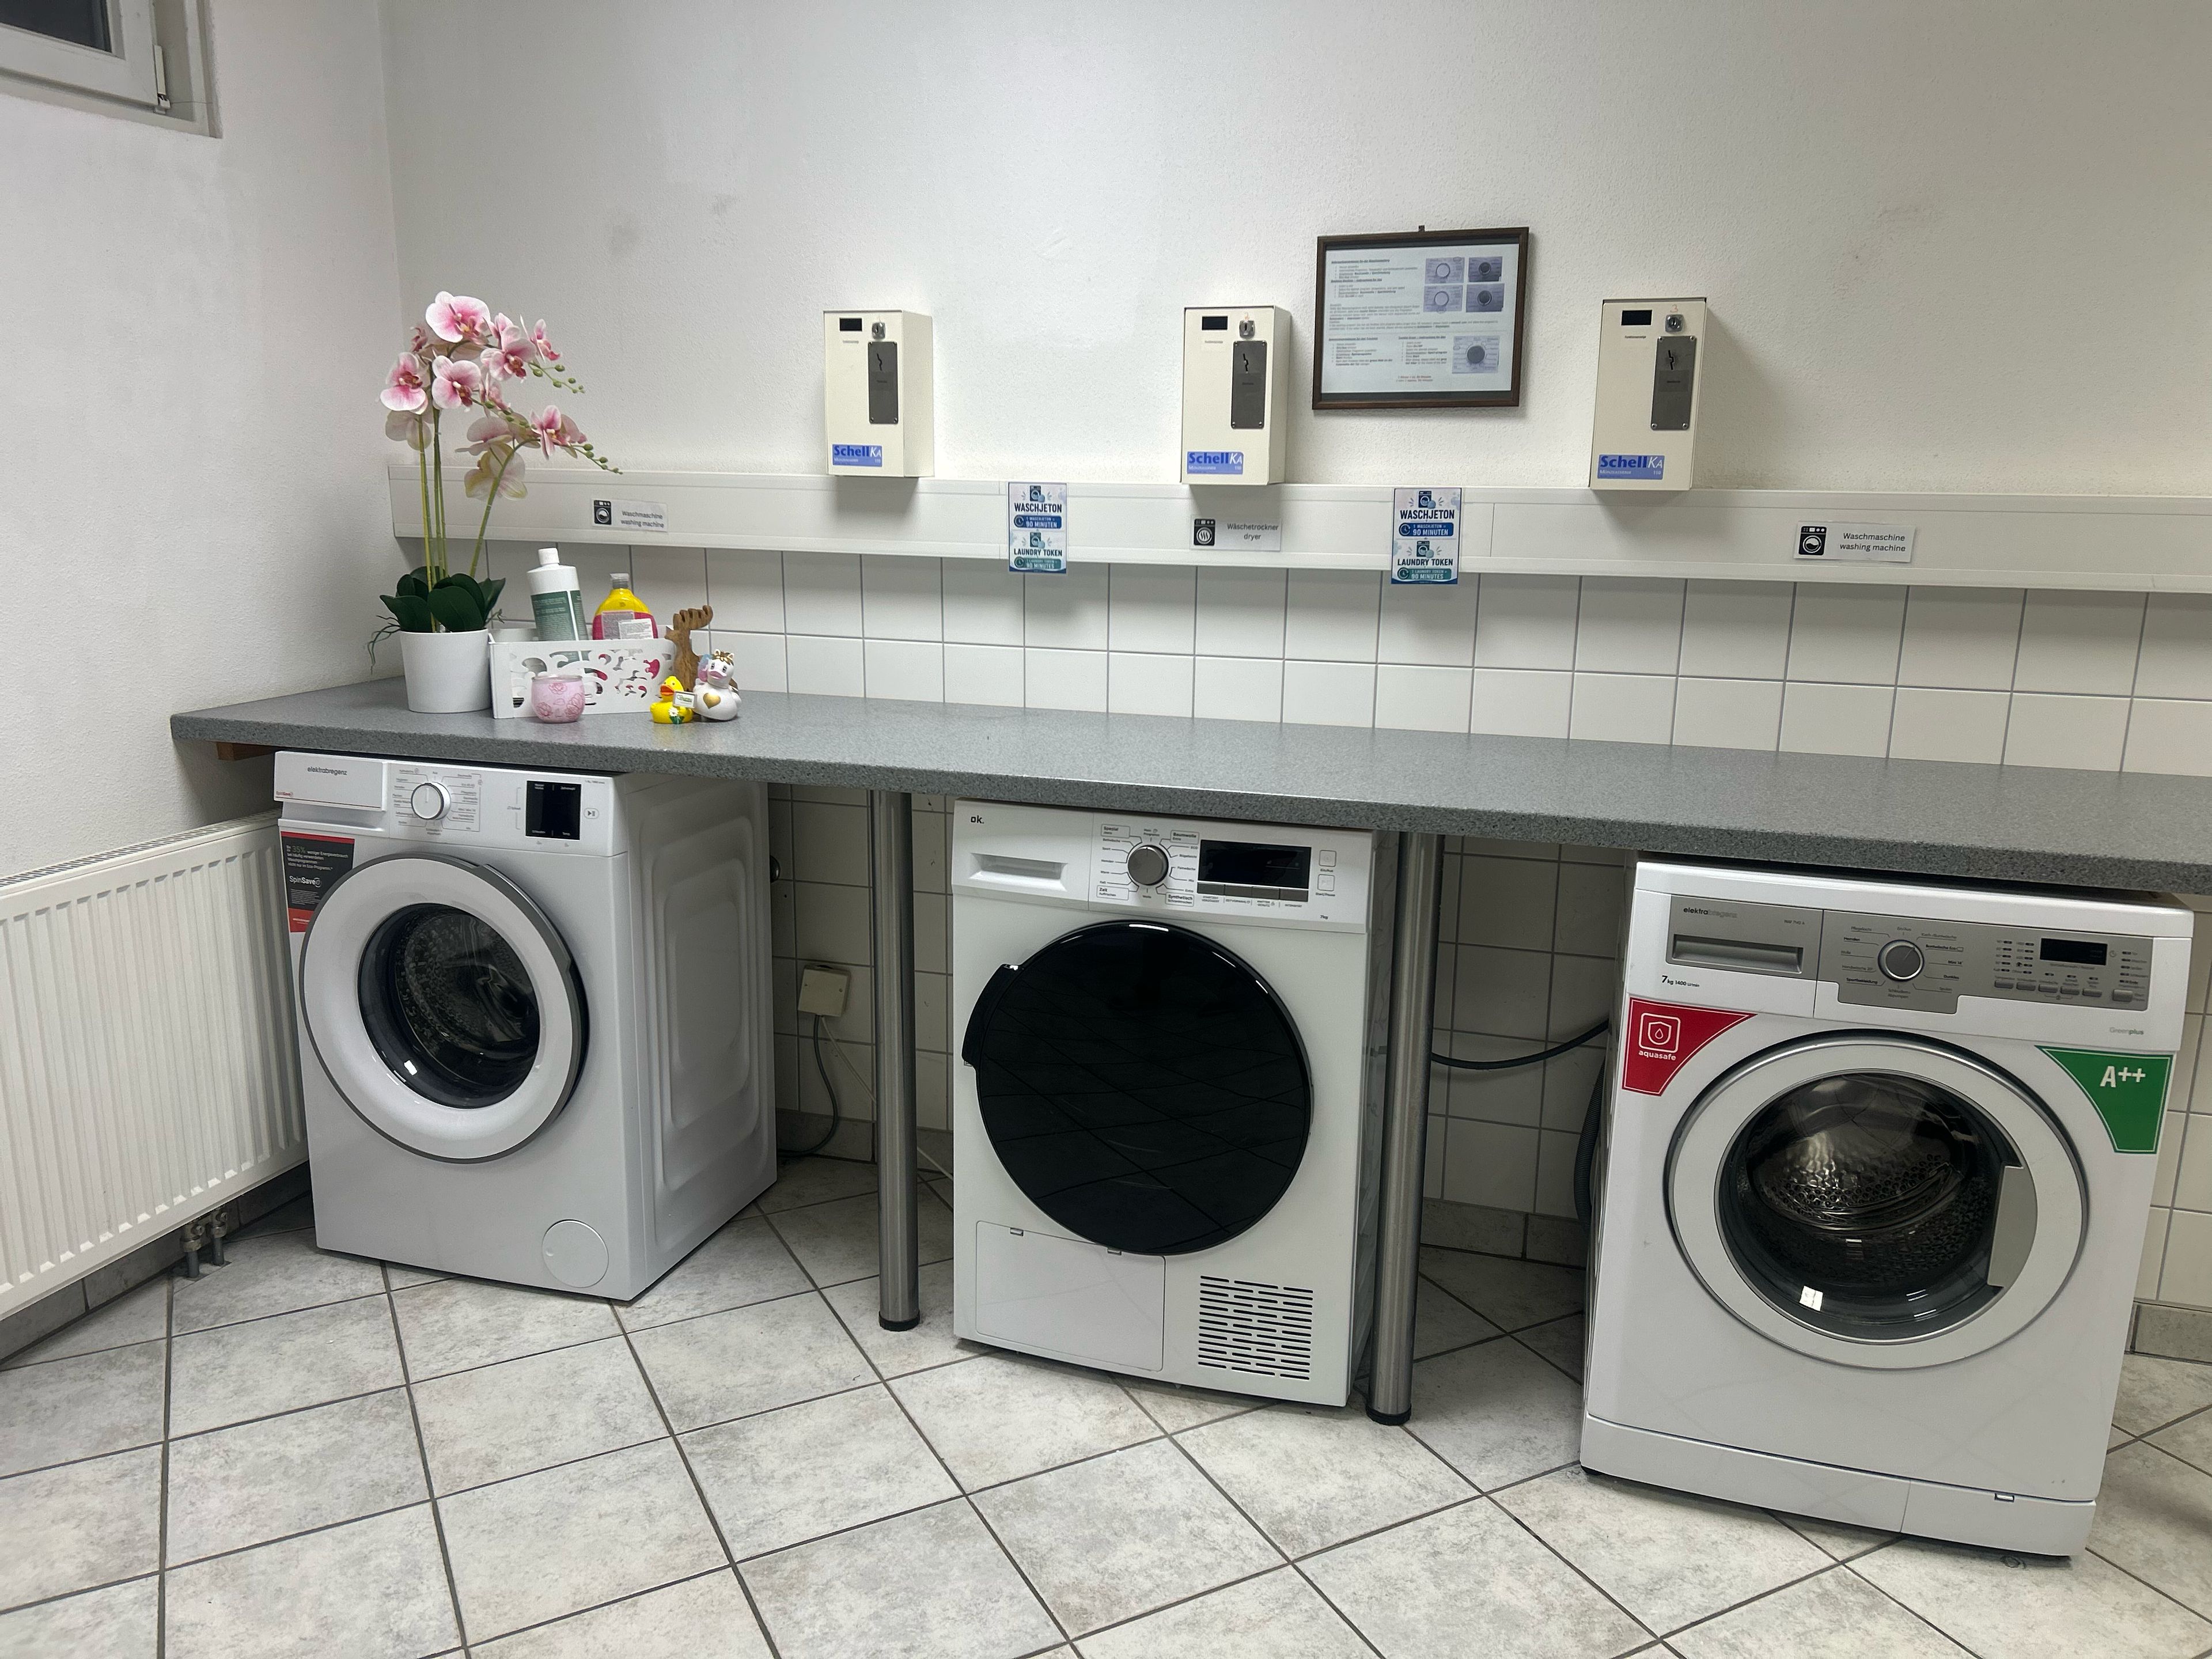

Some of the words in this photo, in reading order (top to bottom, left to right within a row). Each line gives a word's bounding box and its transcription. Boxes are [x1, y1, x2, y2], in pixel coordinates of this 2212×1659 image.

[1014, 503, 1062, 513] WASCHJETON
[622, 511, 662, 519] Waschmaschine
[1400, 510, 1455, 519] WASCHJETON
[1843, 533, 1905, 541] Waschmaschine
[2109, 1027, 2144, 1035] Greenplus
[1639, 1051, 1676, 1060] aquasafe
[2100, 1066, 2146, 1088] A++
